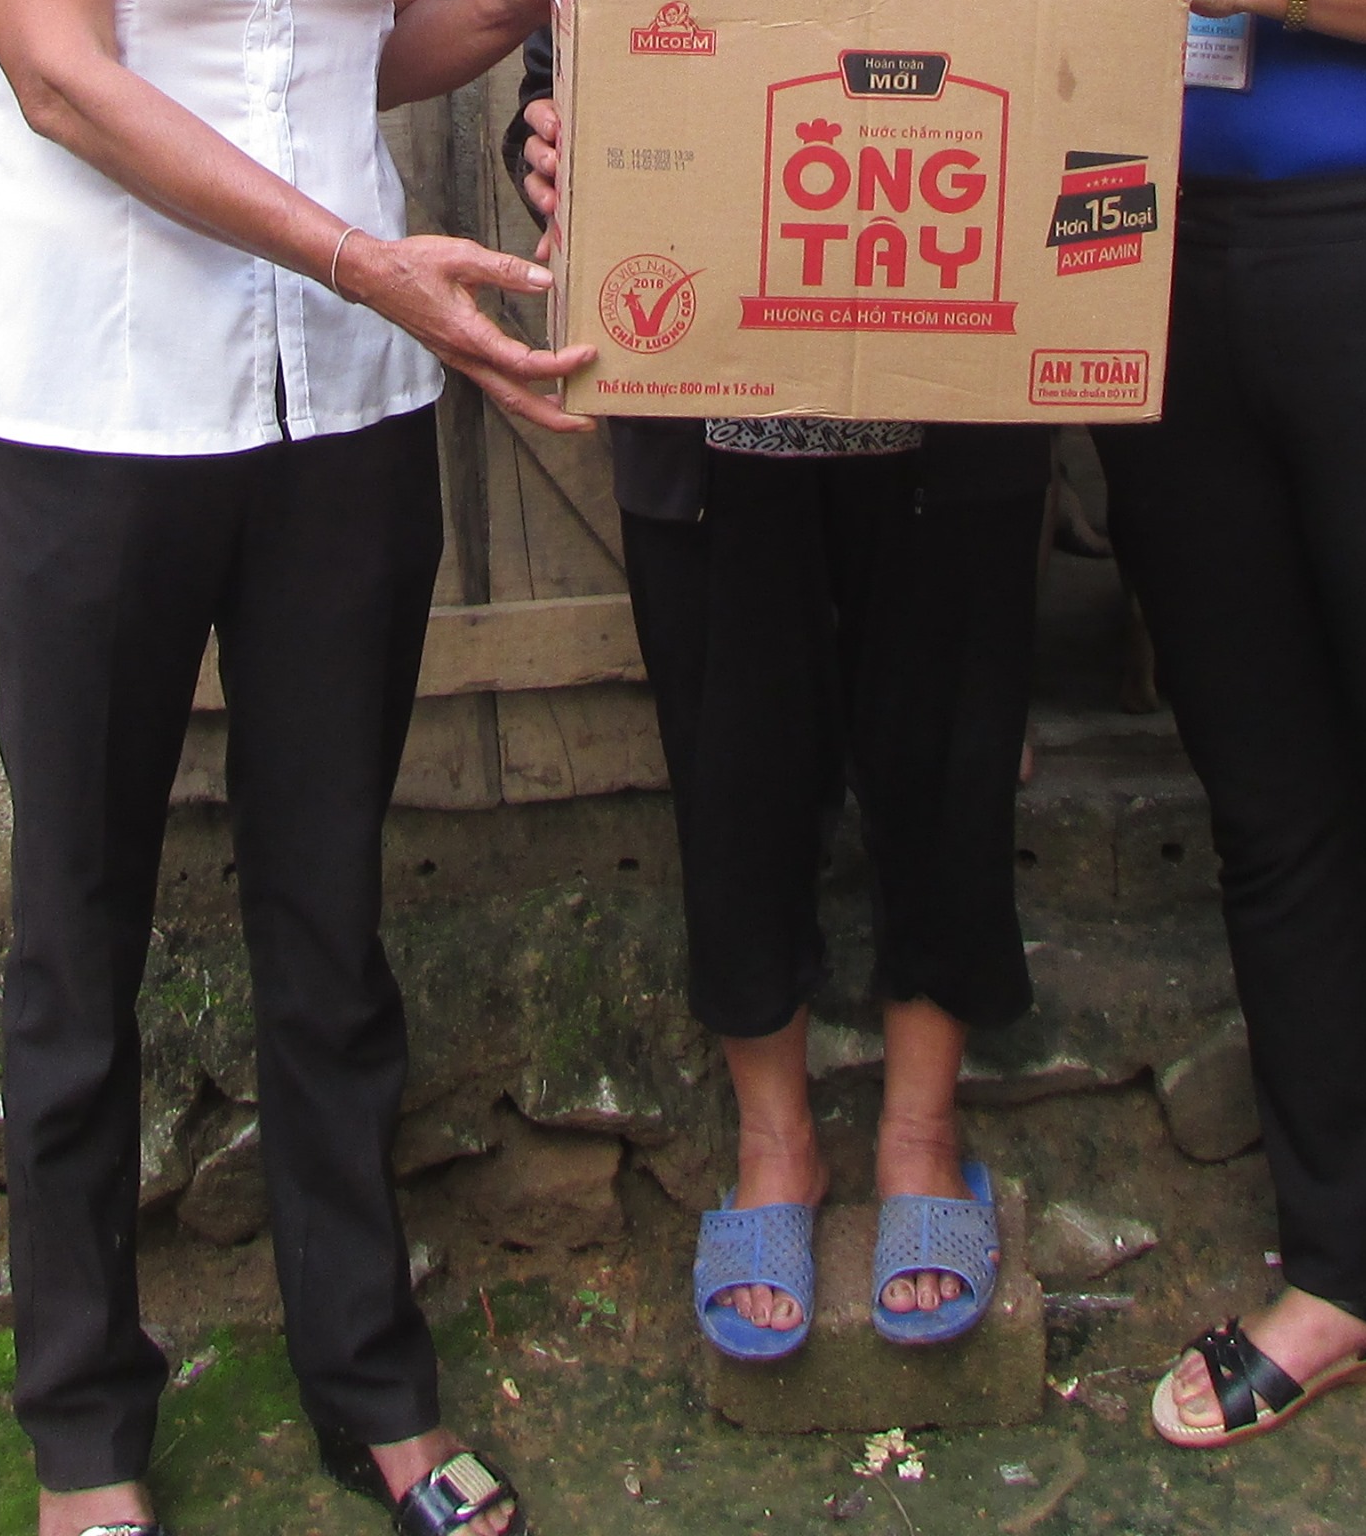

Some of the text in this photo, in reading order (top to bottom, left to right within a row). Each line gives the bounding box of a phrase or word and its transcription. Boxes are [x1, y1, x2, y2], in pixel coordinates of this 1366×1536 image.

[637, 34, 709, 49] MICOEM
[865, 58, 924, 70] Hoàn toàn
[869, 72, 918, 90] MỚI
[860, 125, 983, 142] Nước chấm ngon
[1055, 195, 1153, 237] Hơn 15 loại
[780, 216, 983, 289] TÂY
[1061, 243, 1138, 268] AXIT AMIN
[763, 305, 993, 326] HƯƠNG CÁ HỒI THƠM NGON
[1039, 356, 1140, 384] AN TOÀN
[621, 381, 644, 394] tích
[679, 382, 702, 395] 800
[705, 382, 720, 395] ml
[723, 385, 730, 395] x
[735, 383, 747, 396] 15
